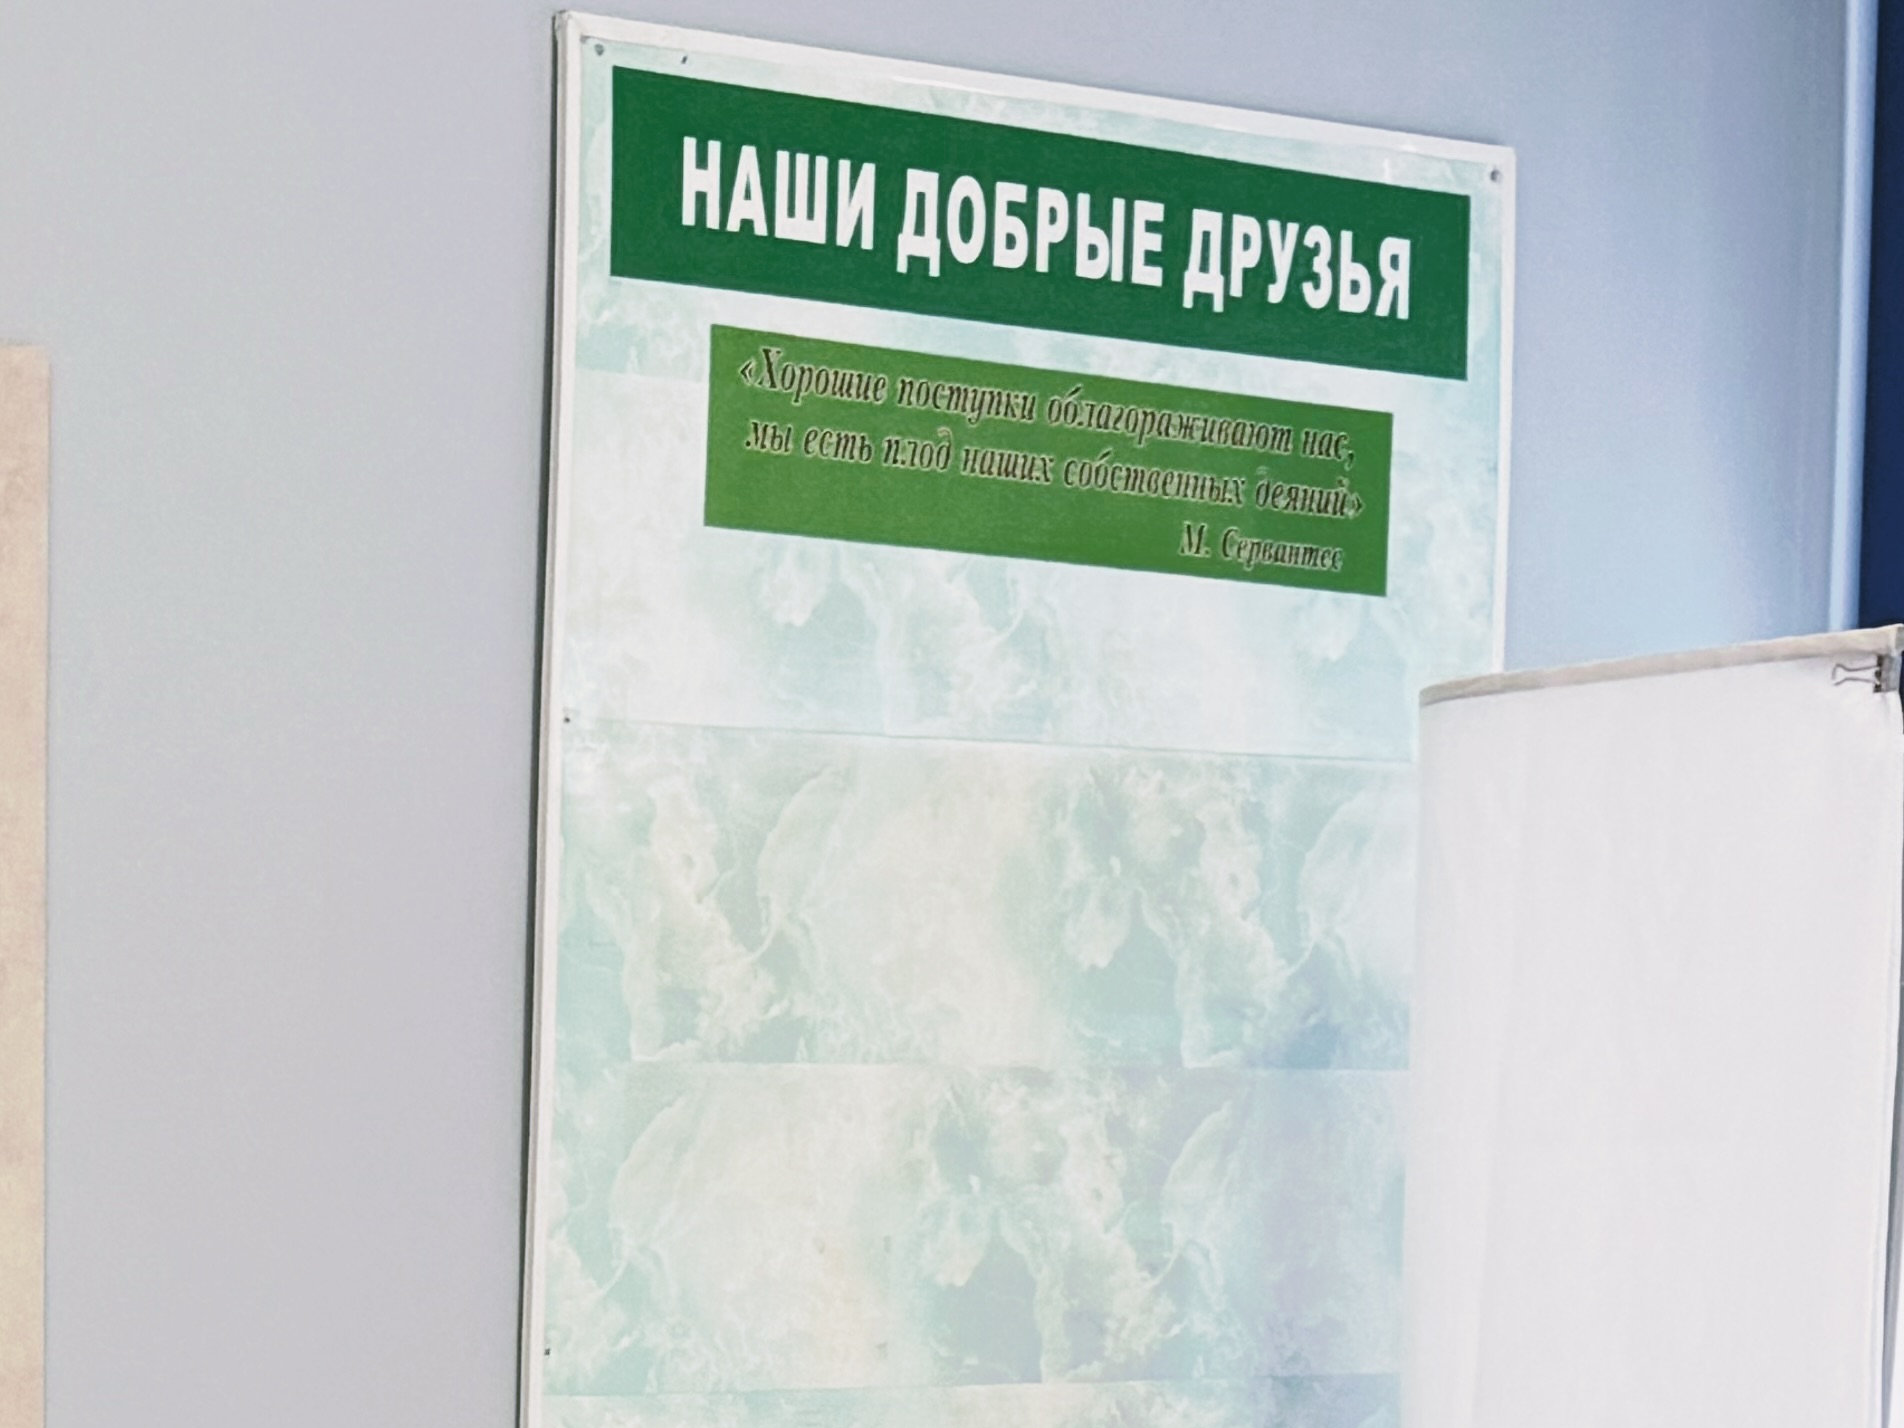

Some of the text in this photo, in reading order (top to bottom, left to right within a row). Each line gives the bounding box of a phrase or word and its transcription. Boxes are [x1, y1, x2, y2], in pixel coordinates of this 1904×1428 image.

[680, 135, 1412, 320] НАШИ ДОБРЫЕ ДРУЗЬЯ
[739, 347, 1355, 470] «Хорошие поступки облагораживают нас,
[744, 421, 1365, 518] мы есть плод наших собственных деяний»
[1180, 522, 1210, 557] М.
